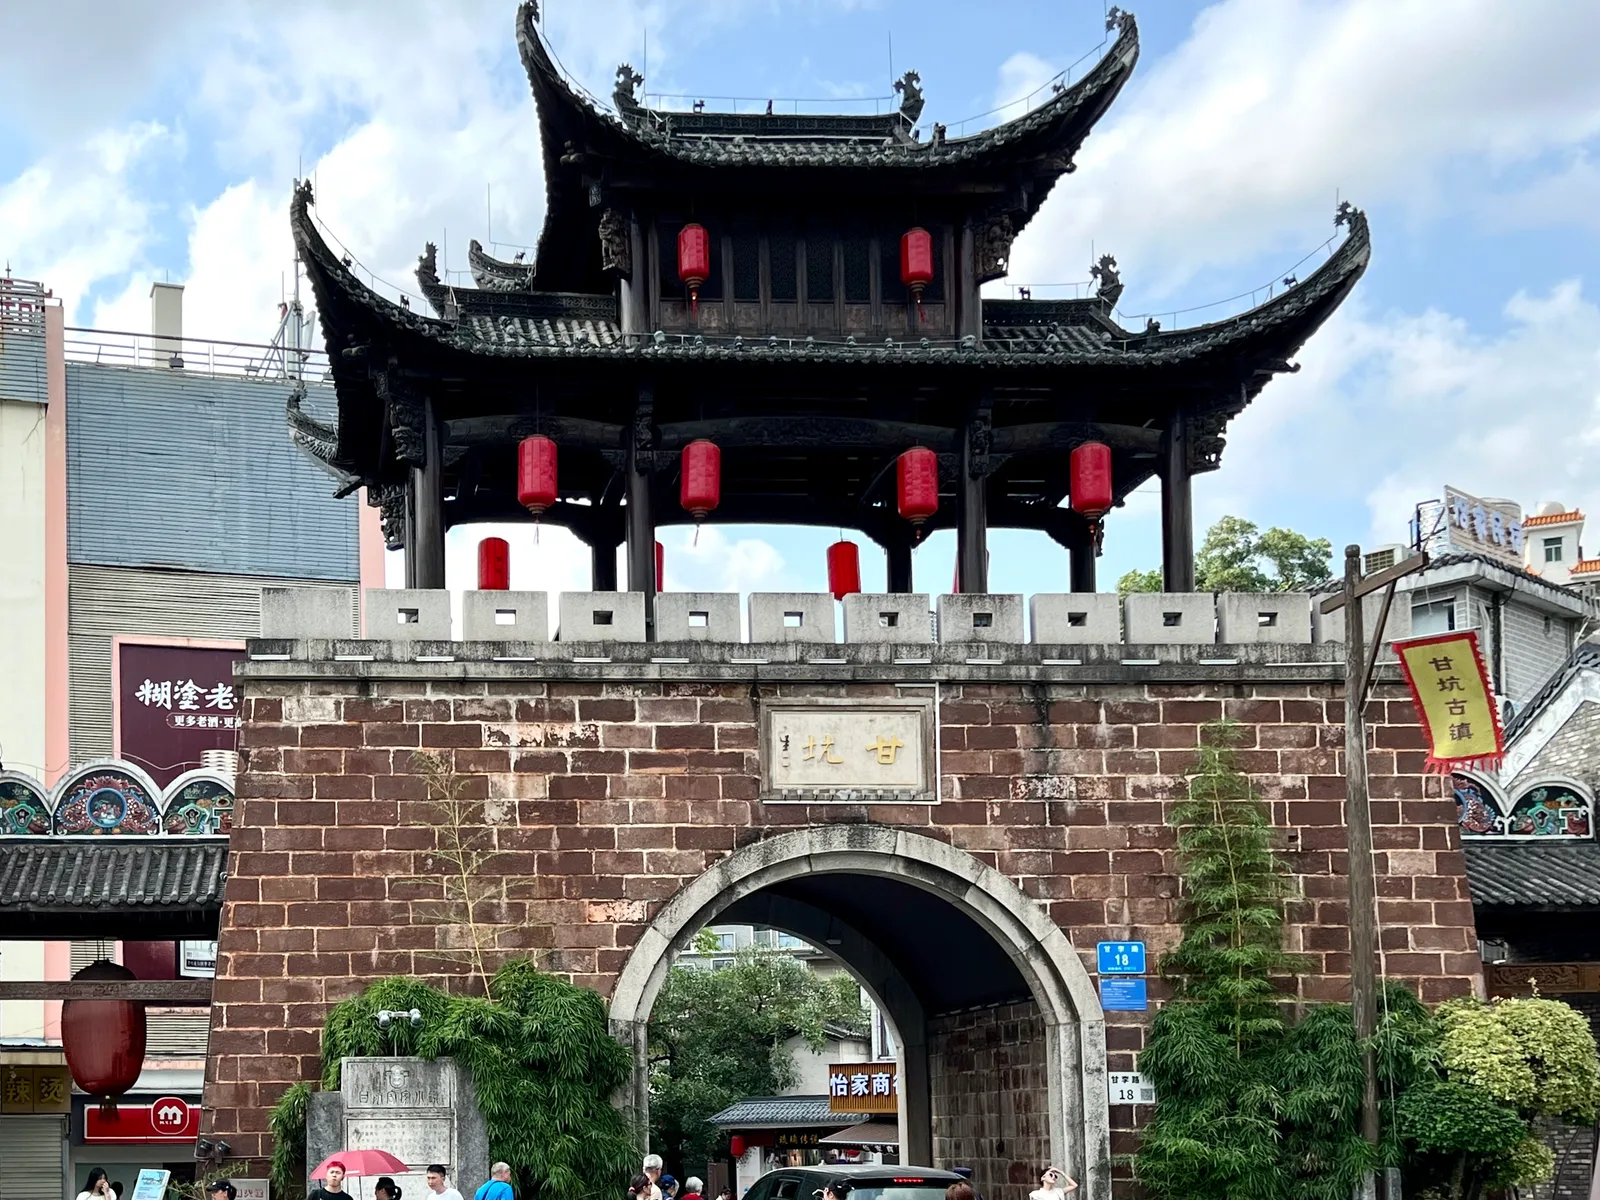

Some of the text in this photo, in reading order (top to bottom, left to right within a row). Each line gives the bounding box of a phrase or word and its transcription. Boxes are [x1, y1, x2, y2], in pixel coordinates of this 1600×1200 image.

[135, 679, 238, 710] 糊塗老
[1429, 656, 1474, 741] 甘坑古镇
[1114, 953, 1129, 966] 18
[1119, 1089, 1134, 1100] 18
